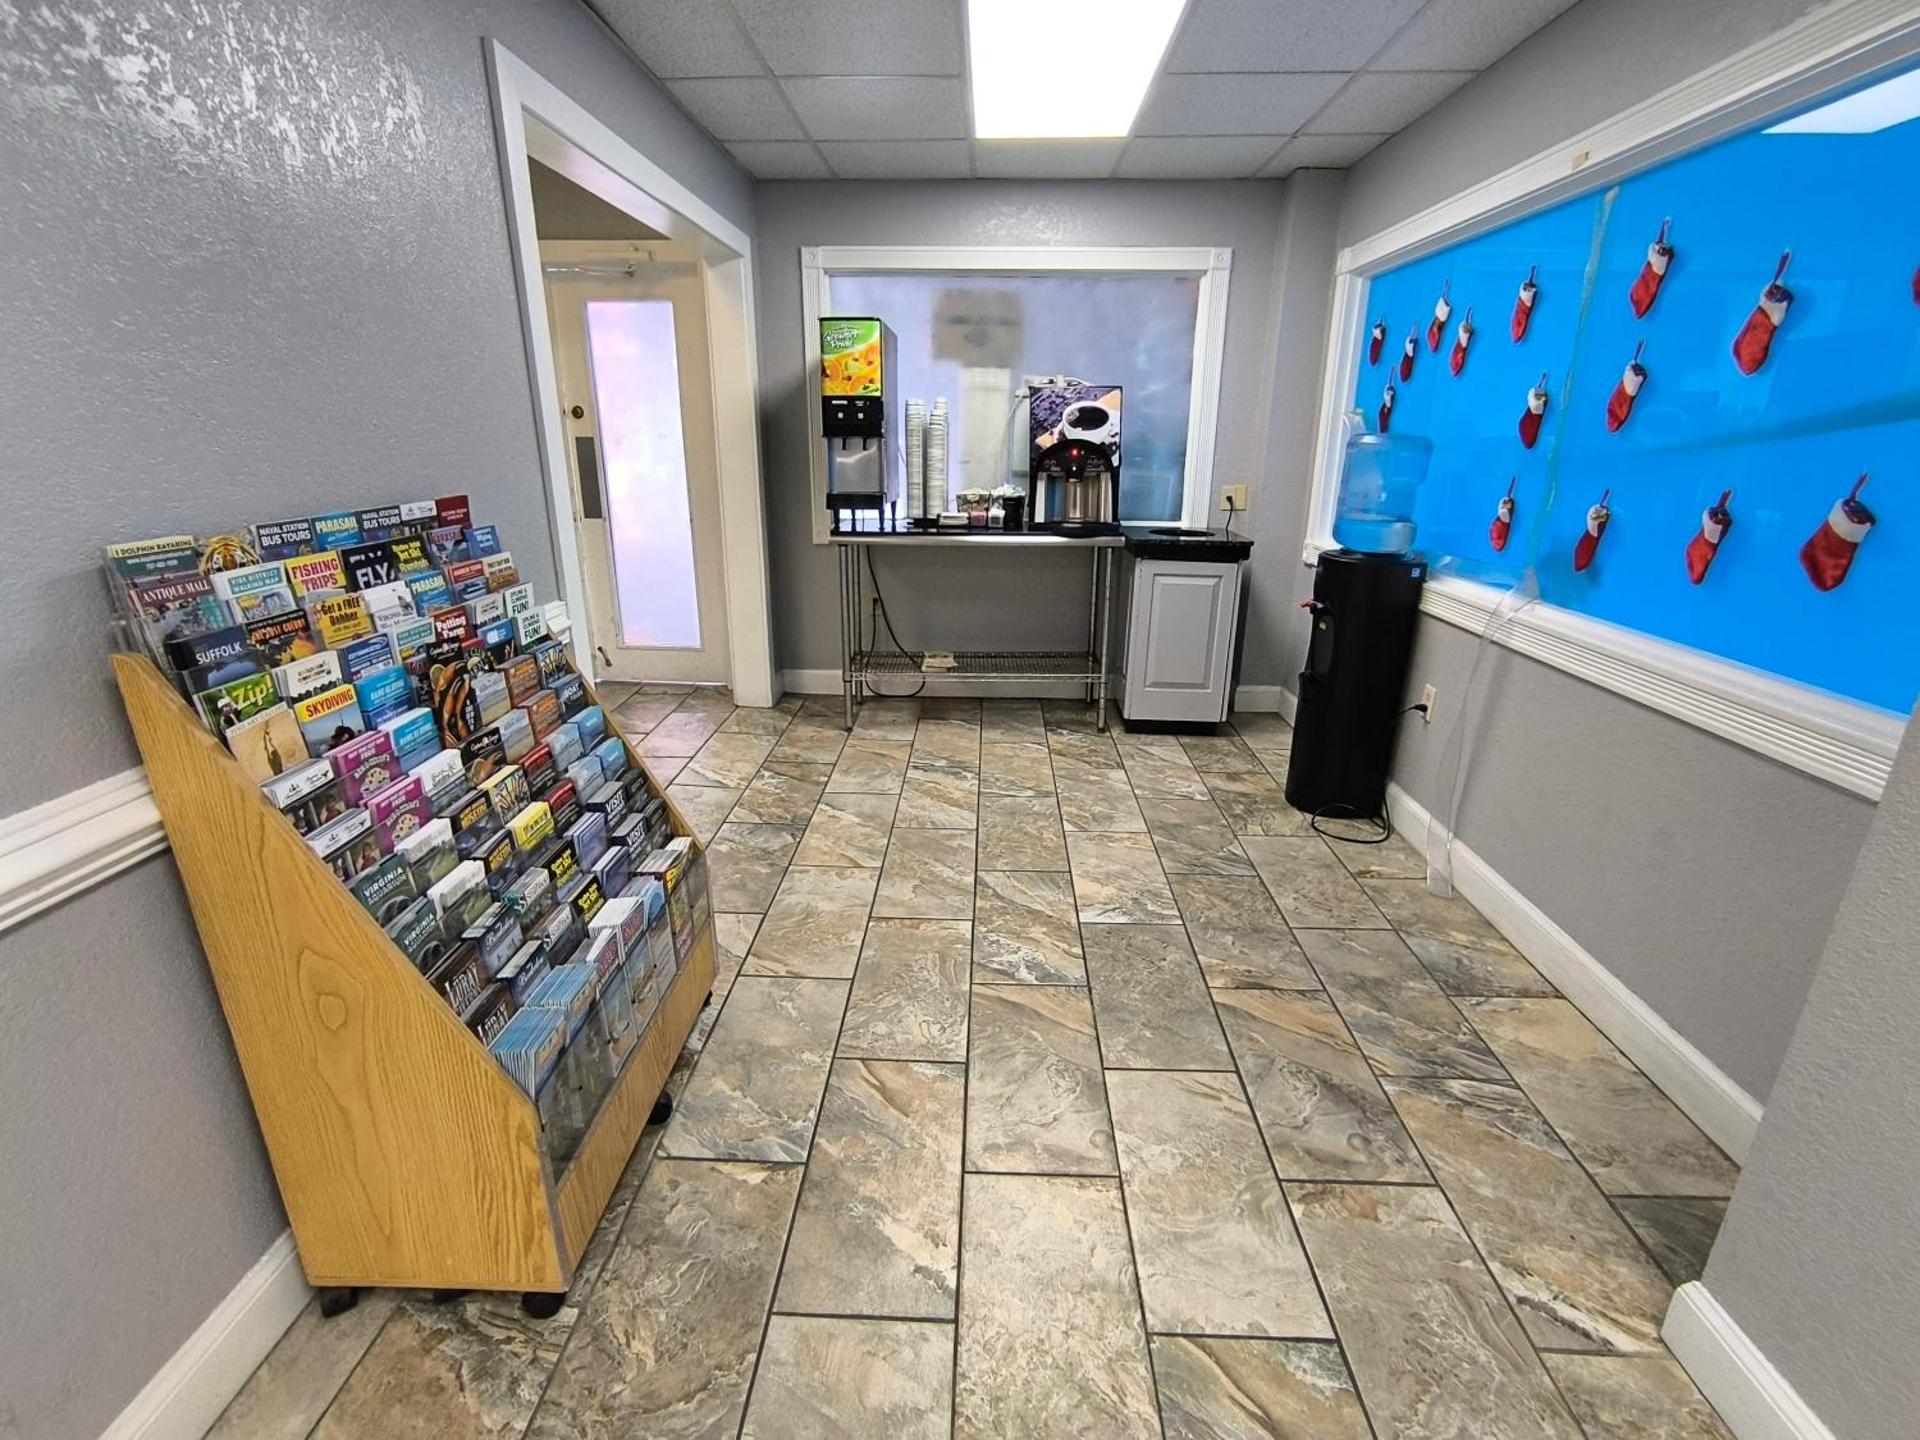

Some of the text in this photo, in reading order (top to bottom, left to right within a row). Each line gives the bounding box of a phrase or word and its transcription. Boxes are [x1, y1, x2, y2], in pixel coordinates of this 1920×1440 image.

[260, 521, 309, 536] NAVAL STATION
[315, 516, 358, 534] PARASAIL
[261, 530, 312, 547] BUS TOURS
[291, 558, 340, 579] FISHING
[142, 580, 211, 602] ANTIQUE MALL
[301, 573, 339, 592] TRIPS
[321, 596, 361, 615] Get a FREE
[435, 616, 467, 632] Petting
[195, 641, 243, 665] SUFFOLK
[231, 674, 274, 710] Zip!
[305, 688, 354, 718] SKYDIVING
[605, 789, 625, 813] VISIT
[364, 867, 404, 897] VIRGINIA
[367, 873, 407, 905] AQUARIUM
[403, 913, 435, 946] VIRGINIA
